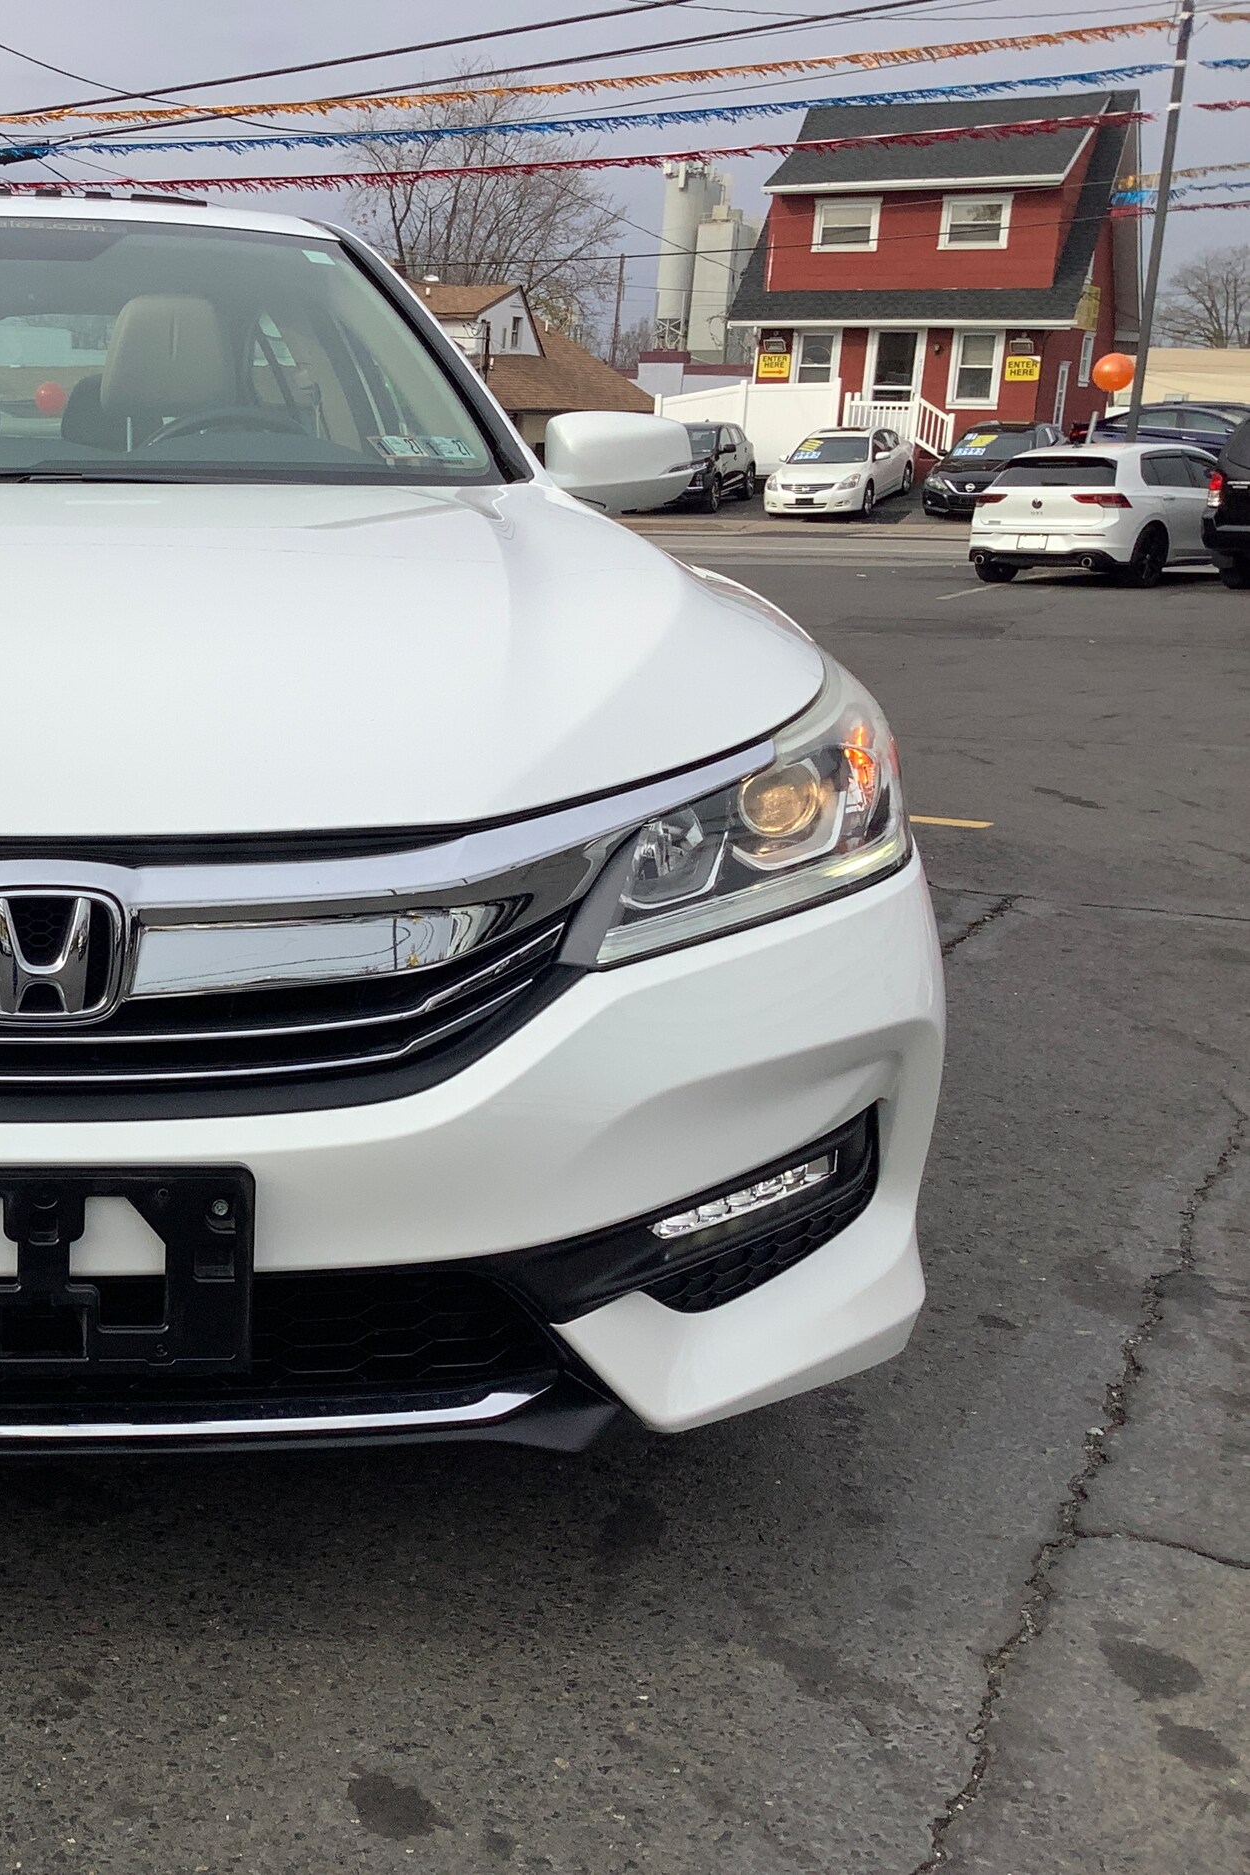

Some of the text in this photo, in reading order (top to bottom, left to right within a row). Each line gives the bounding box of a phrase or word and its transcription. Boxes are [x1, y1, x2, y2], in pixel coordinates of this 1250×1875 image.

[762, 355, 788, 363] ENTER
[763, 361, 785, 369] HERE
[1008, 360, 1038, 369] ENTER
[1009, 368, 1035, 377] HERE
